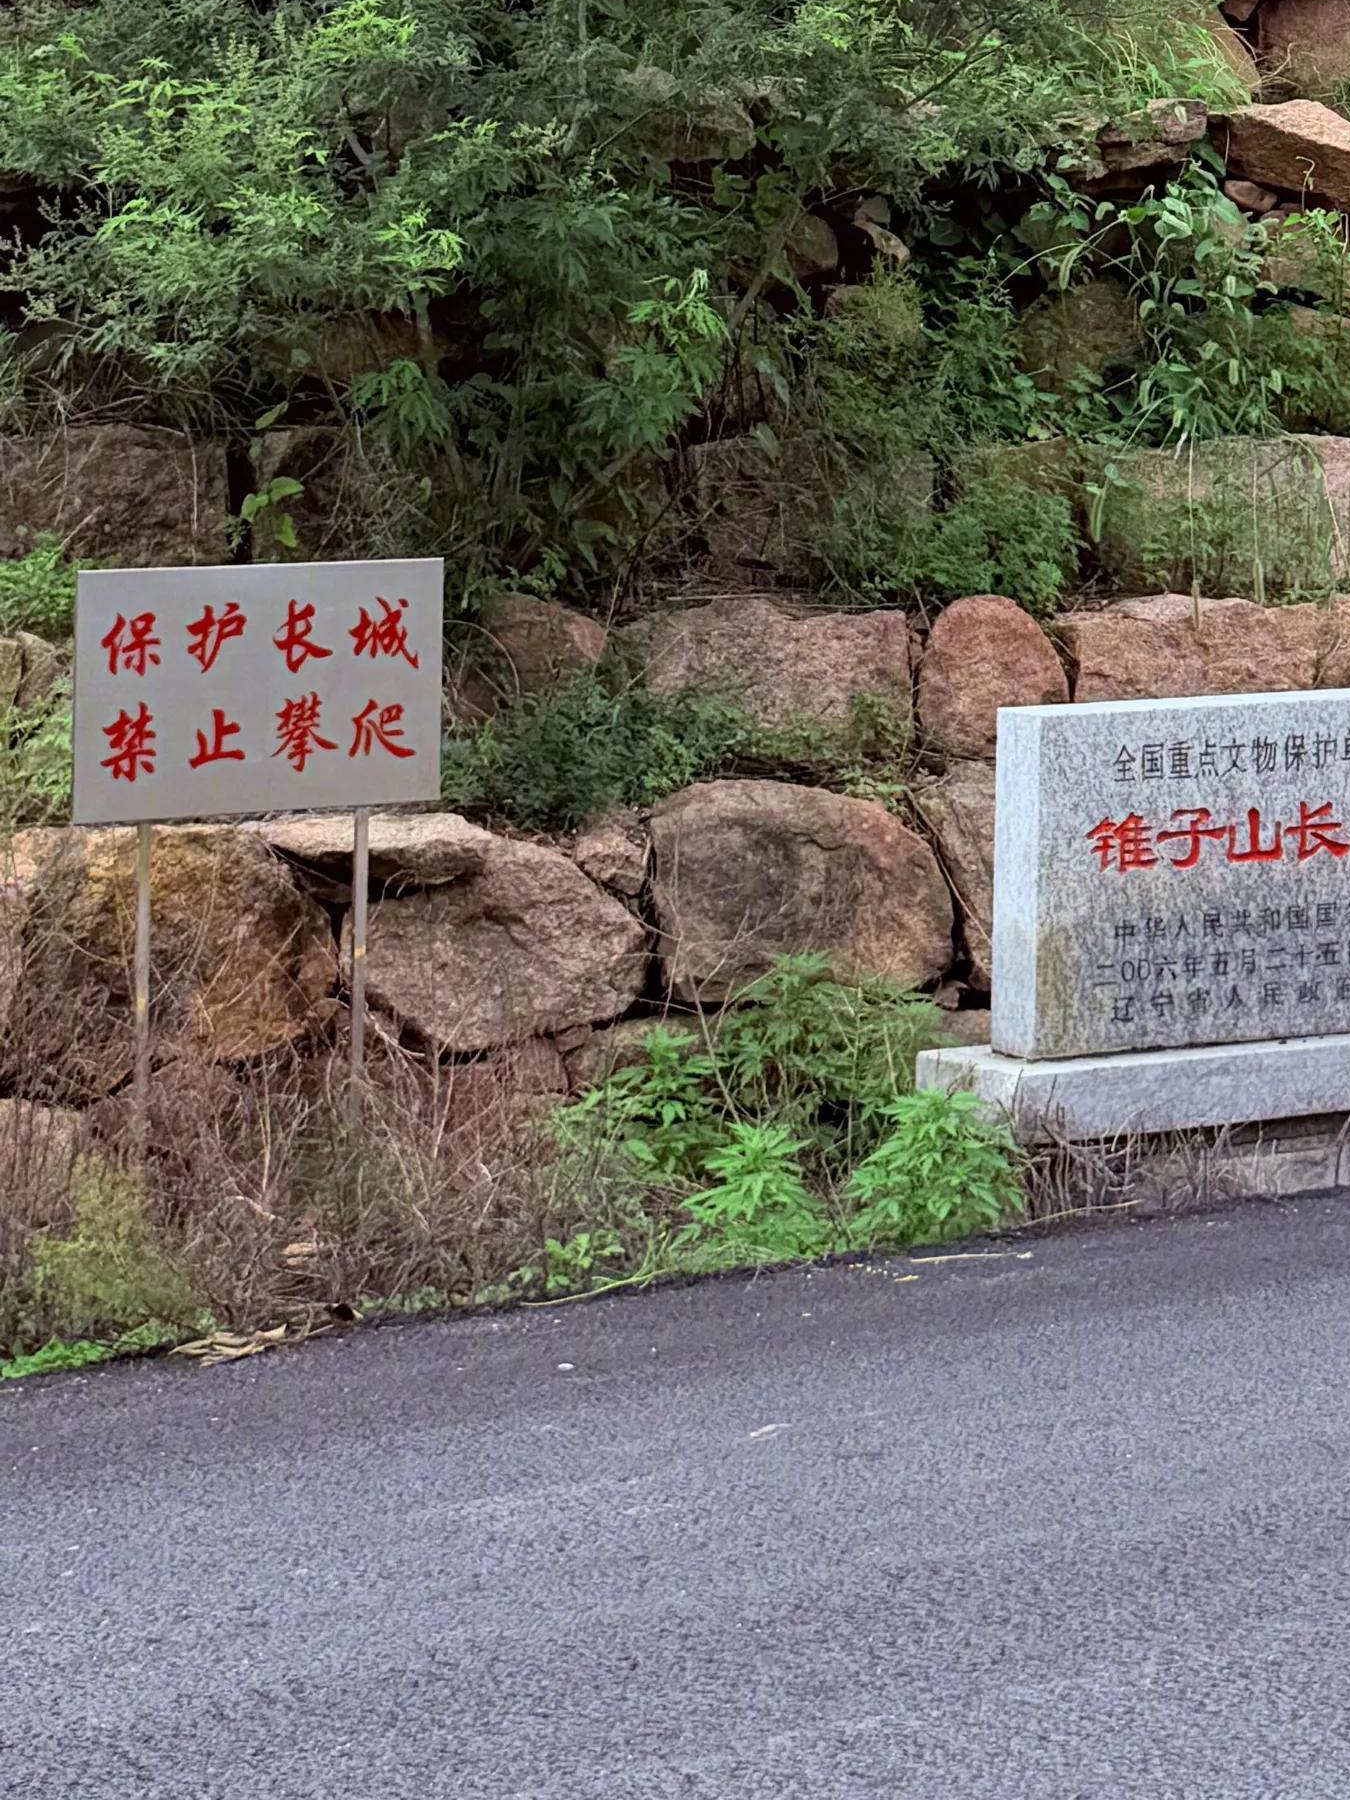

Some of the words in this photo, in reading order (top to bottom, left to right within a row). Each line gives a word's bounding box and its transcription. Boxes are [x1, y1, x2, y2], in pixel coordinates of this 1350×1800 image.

[101, 596, 420, 677] 保护长城
[100, 691, 417, 783] 禁止攀爬
